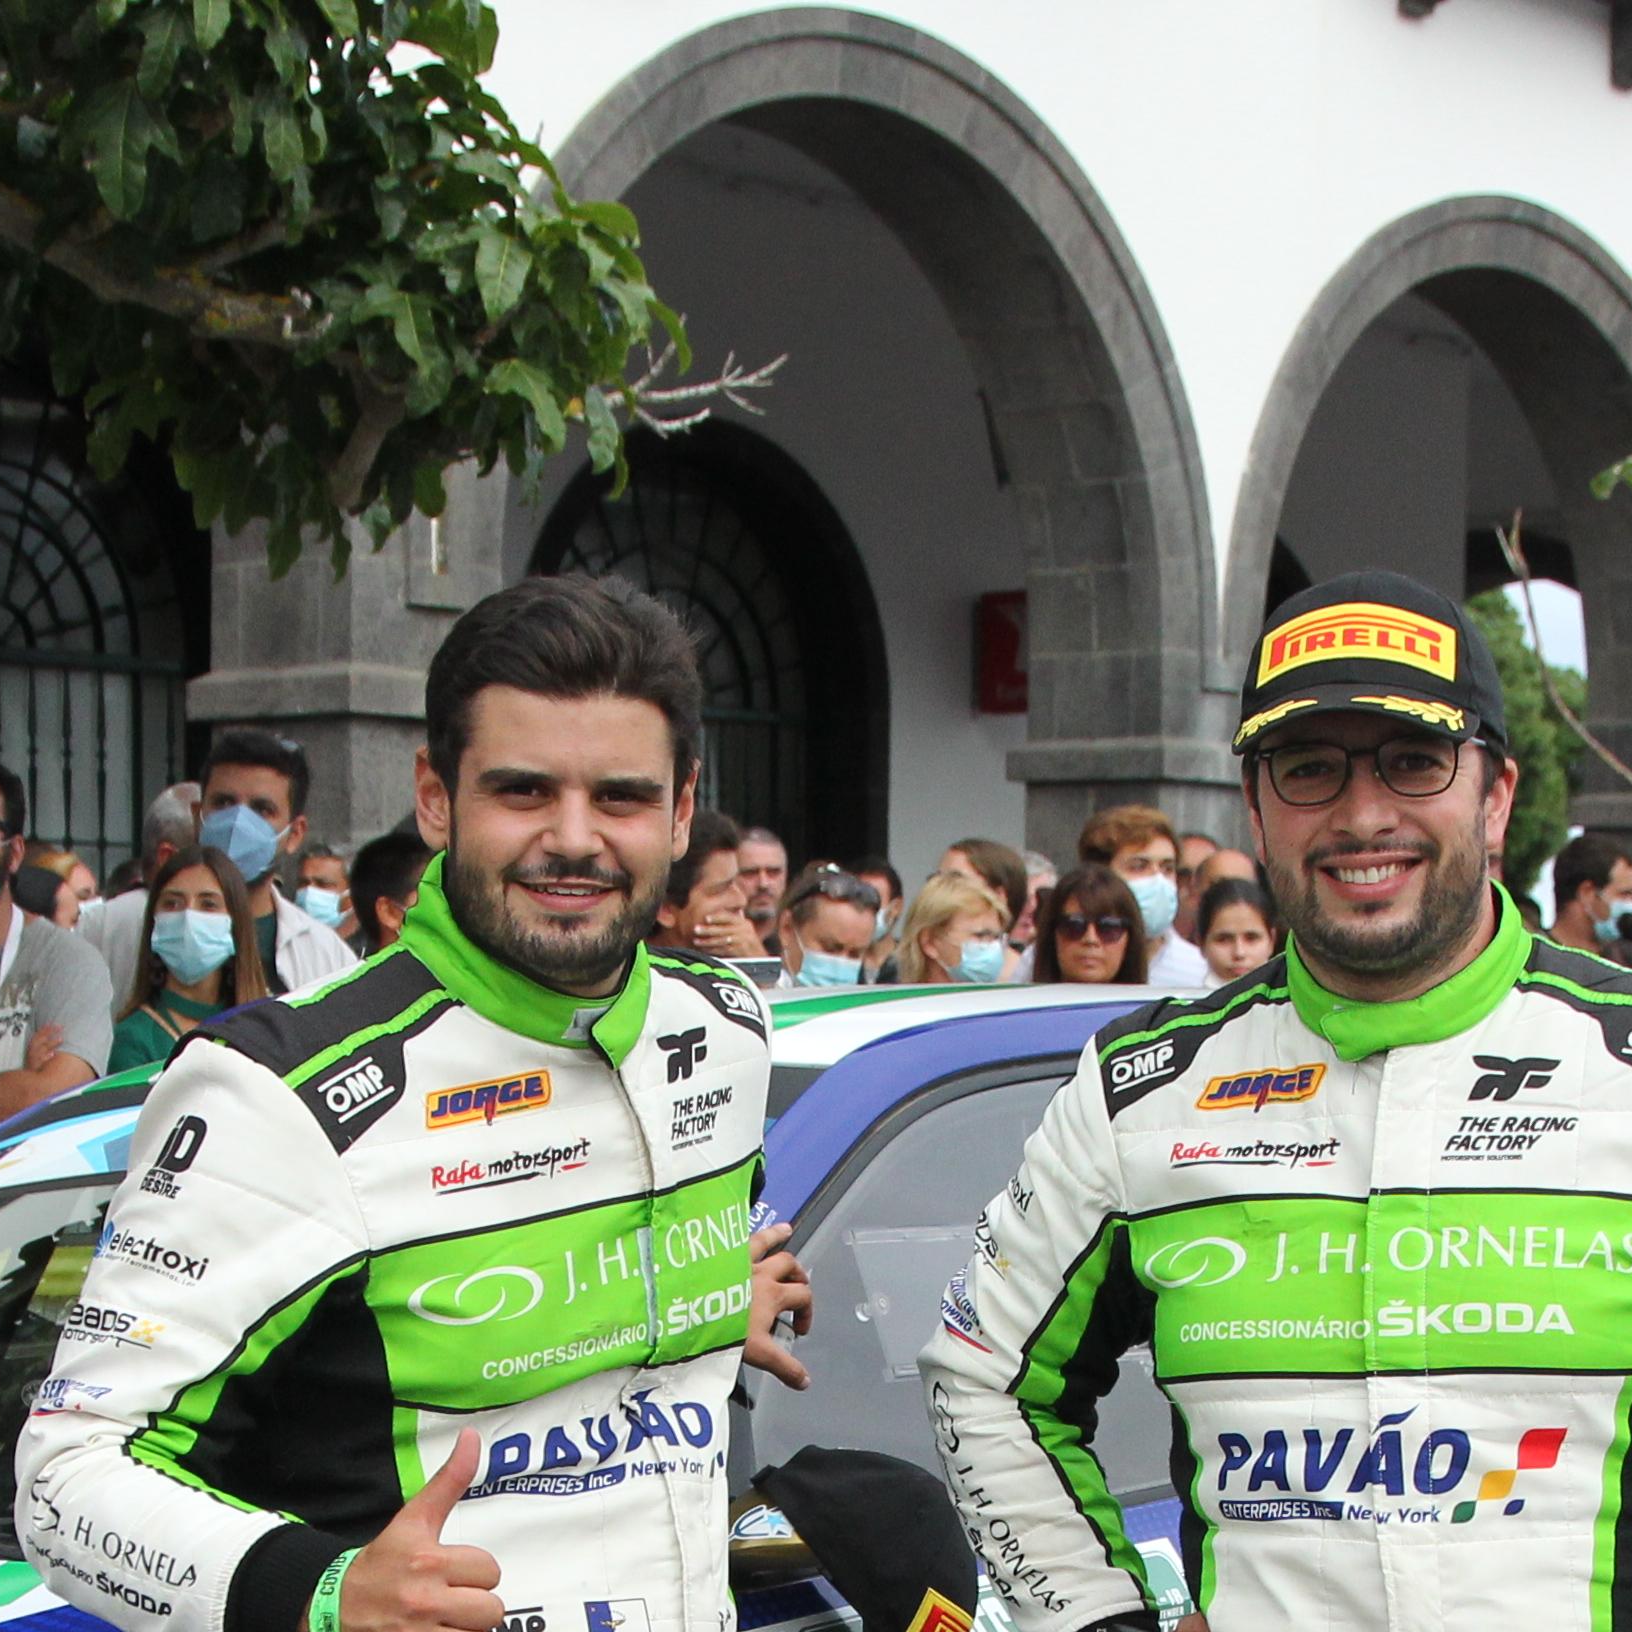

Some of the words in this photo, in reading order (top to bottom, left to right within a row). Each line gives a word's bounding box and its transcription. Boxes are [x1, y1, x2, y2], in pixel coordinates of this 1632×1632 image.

[1268, 614, 1441, 670] PIRELLI
[1112, 1049, 1174, 1080] OMP
[1205, 1068, 1313, 1104] JORGE
[326, 1064, 385, 1113] OMP
[430, 1076, 544, 1121] JORGE
[673, 1100, 695, 1118] THE
[696, 1086, 733, 1112] RACING
[671, 1111, 717, 1141] FACTORY
[1443, 1135, 1543, 1150] FACTORY
[1458, 1117, 1500, 1132] THE
[1503, 1117, 1579, 1132] RACING
[432, 1160, 484, 1190] Rafa
[487, 1137, 591, 1176] motorsport
[1169, 1142, 1222, 1162] Rafa
[1224, 1138, 1342, 1168] motorsport
[109, 1229, 210, 1281] electroxi
[564, 1250, 587, 1304] J.
[598, 1236, 640, 1286] H.
[1265, 1232, 1300, 1284] J.
[1321, 1231, 1371, 1276] H.
[667, 1281, 752, 1337] ŠKODA
[1180, 1315, 1370, 1343] CONCESSIONÁRIO
[1377, 1299, 1576, 1338] ŠKODA
[1216, 1404, 1472, 1496] PAVÃO
[469, 1477, 584, 1497] ENTERPRISES
[588, 1469, 618, 1490] Inc.
[1222, 1501, 1311, 1520] ENTERPRISES
[1346, 1504, 1392, 1525] New
[1397, 1504, 1441, 1524] York
[989, 1518, 1072, 1615] ORNELAS
[95, 1573, 173, 1618] ŠKODA
